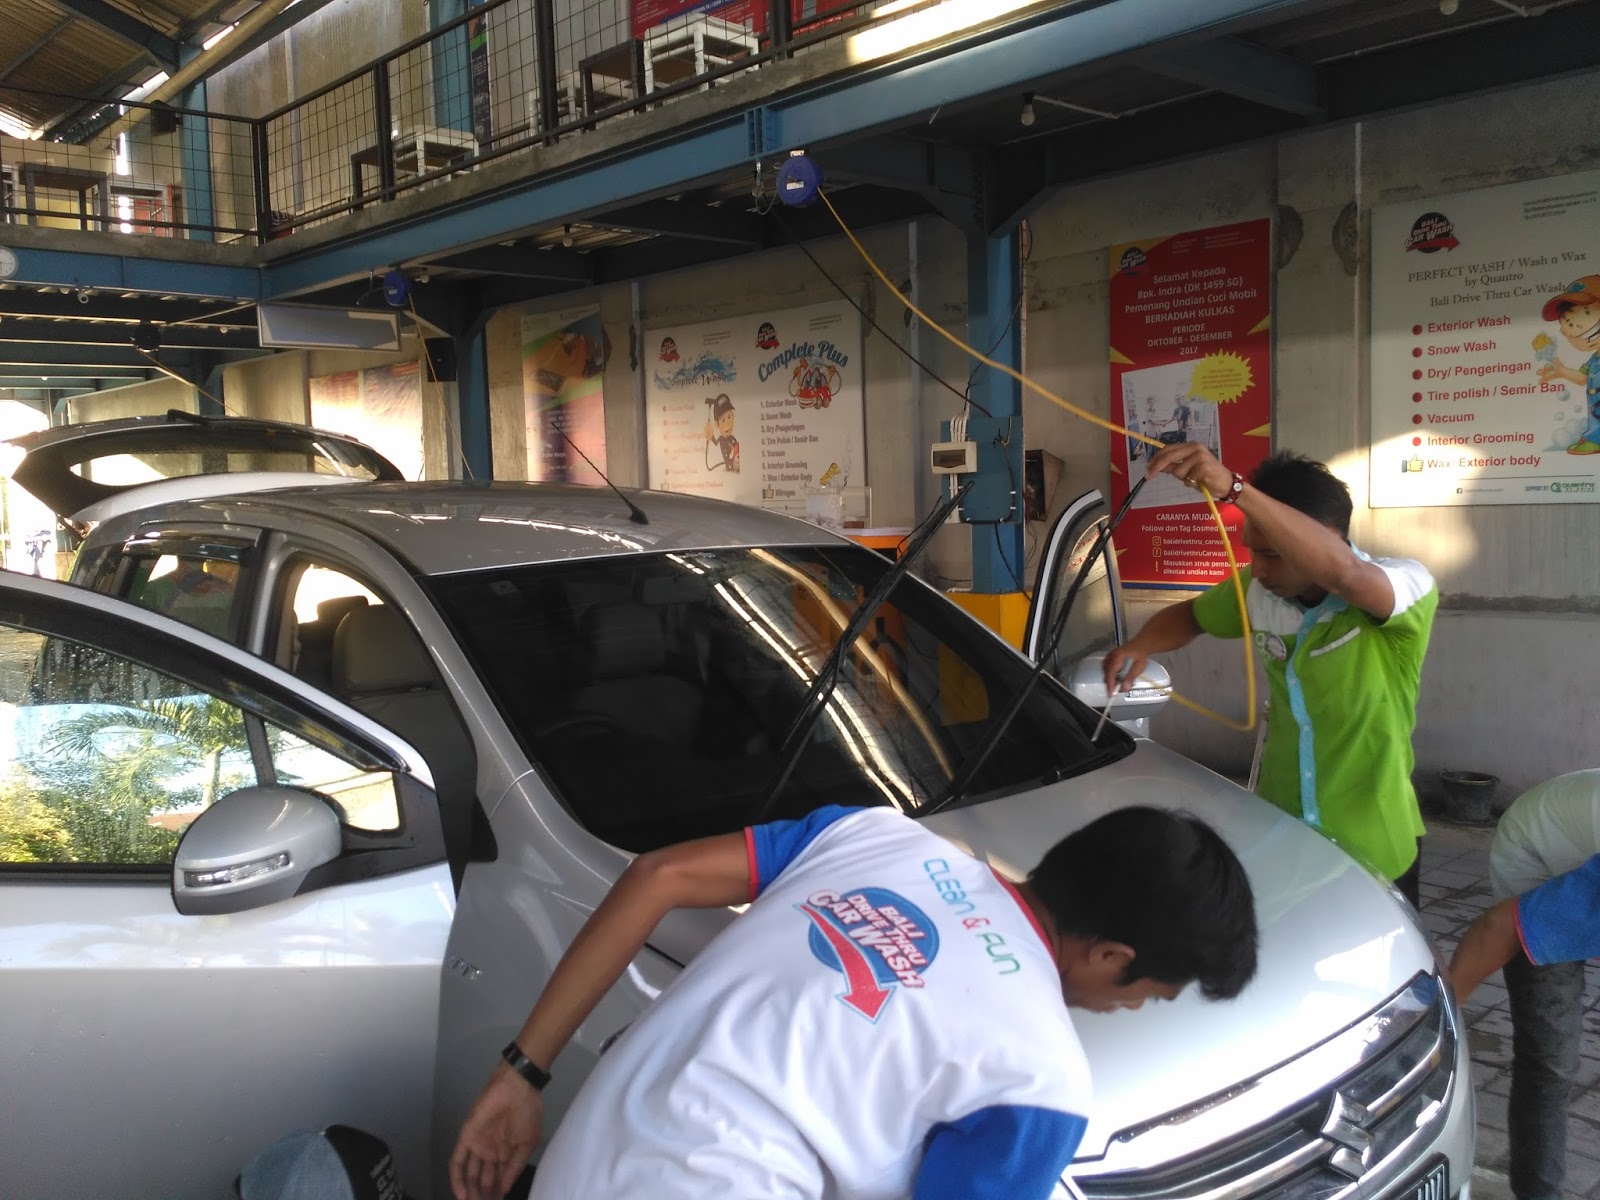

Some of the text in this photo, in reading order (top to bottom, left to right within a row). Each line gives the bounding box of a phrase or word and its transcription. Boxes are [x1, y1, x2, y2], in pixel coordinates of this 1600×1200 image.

[1421, 217, 1438, 227] BALI
[1405, 223, 1453, 247] CAR WASH
[1408, 265, 1464, 282] PERFECT
[1468, 260, 1506, 275] WASH
[1518, 255, 1548, 268] Wash
[1561, 250, 1587, 263] Wax
[1153, 266, 1226, 284] Selamat Kepada
[1464, 272, 1523, 289] by Quantro
[1137, 276, 1243, 301] Bpk. Indra (DK 1459 SG)
[1430, 282, 1566, 307] Bali Drive Thru Car Wash
[1125, 288, 1257, 314] Pemenang Undian Cuci Mobil
[1145, 305, 1235, 324] BERHADIAH KULKAS
[1172, 323, 1205, 334] PERIODE
[1427, 315, 1511, 333] Exterior Wash
[1147, 335, 1183, 347] OKTOBER
[1190, 331, 1233, 343] DESEMBER
[1179, 346, 1198, 355] 2017
[1427, 340, 1496, 356] Snow Wash
[758, 340, 849, 382] Complete Plus
[1455, 361, 1531, 376] Pengeringan
[1427, 390, 1450, 401] Tire
[1453, 388, 1490, 402] polish
[1500, 384, 1537, 395] Semir
[1540, 382, 1565, 393] Ban
[1427, 412, 1474, 424] Vacuum
[1427, 432, 1534, 446] Interior Grooming
[1459, 457, 1506, 468] Exterior
[1509, 455, 1541, 467] body
[1156, 513, 1221, 521] CARANYA MUDA
[1179, 525, 1191, 533] Tag
[1163, 559, 1193, 567] Masukkan
[1209, 568, 1225, 576] kami
[846, 894, 929, 966] DRIVE THRU
[877, 905, 926, 941] BALI
[806, 888, 926, 989] CAR WASH
